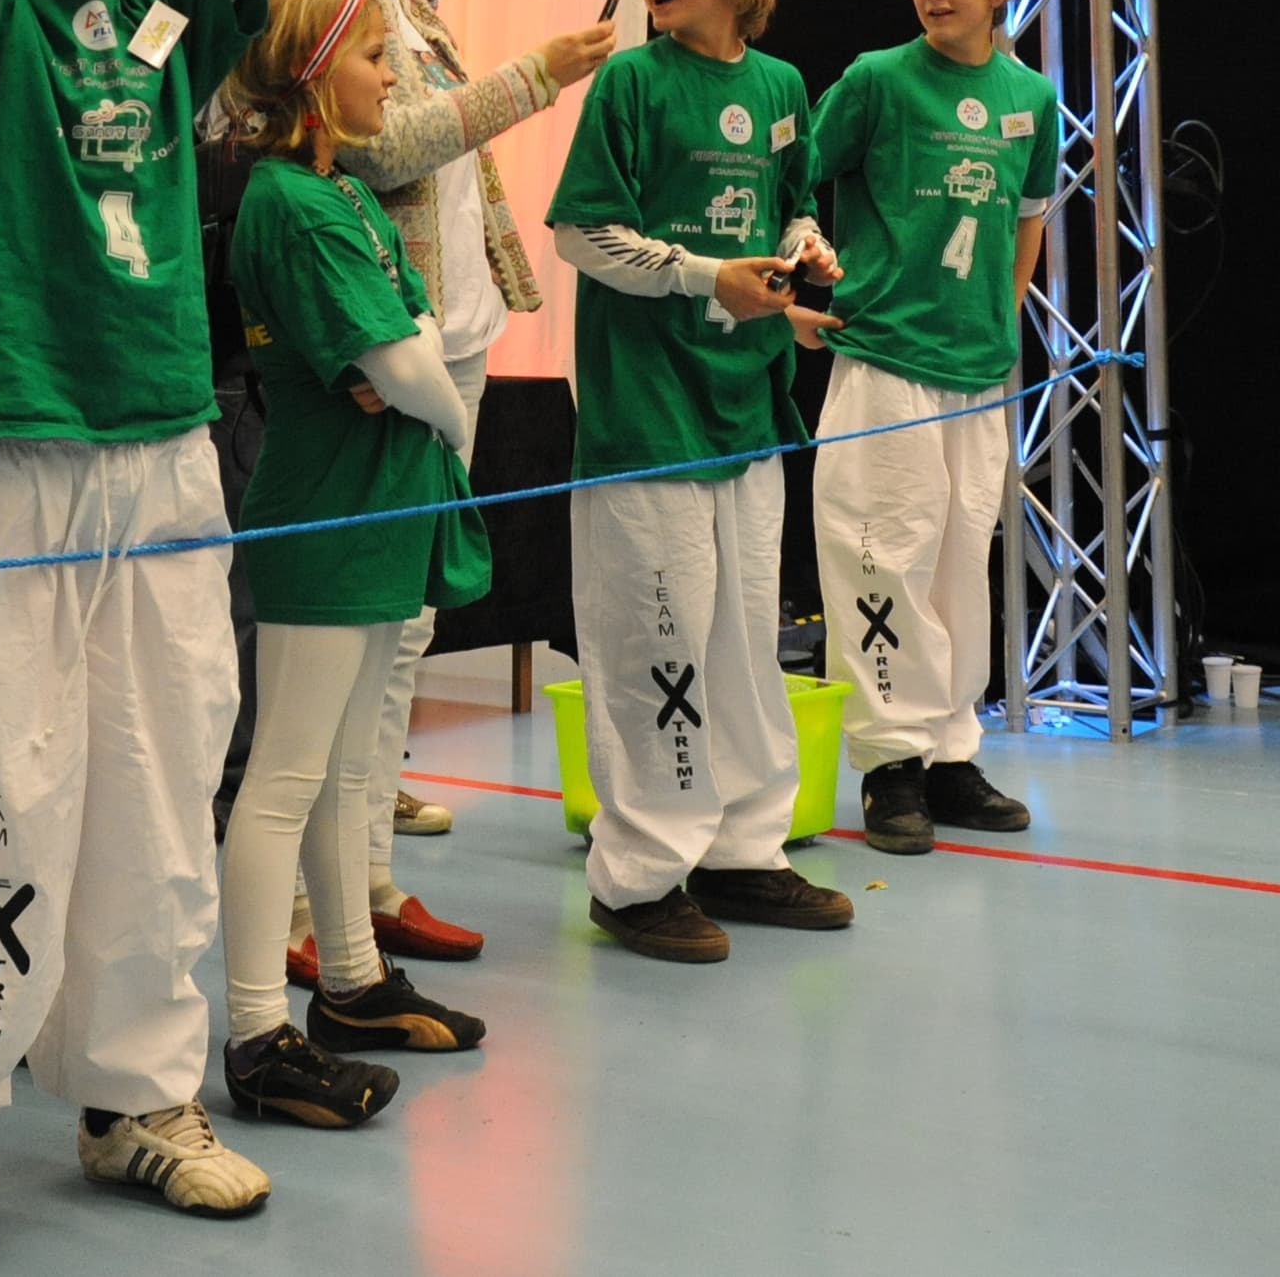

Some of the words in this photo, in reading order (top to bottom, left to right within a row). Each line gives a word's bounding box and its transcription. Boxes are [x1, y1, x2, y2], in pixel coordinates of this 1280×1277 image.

[914, 188, 942, 198] TEAM
[98, 190, 150, 279] 4
[670, 223, 702, 234] TEAM
[941, 215, 978, 280] 4
[860, 521, 877, 576] TEAM
[654, 570, 675, 637] TEAM
